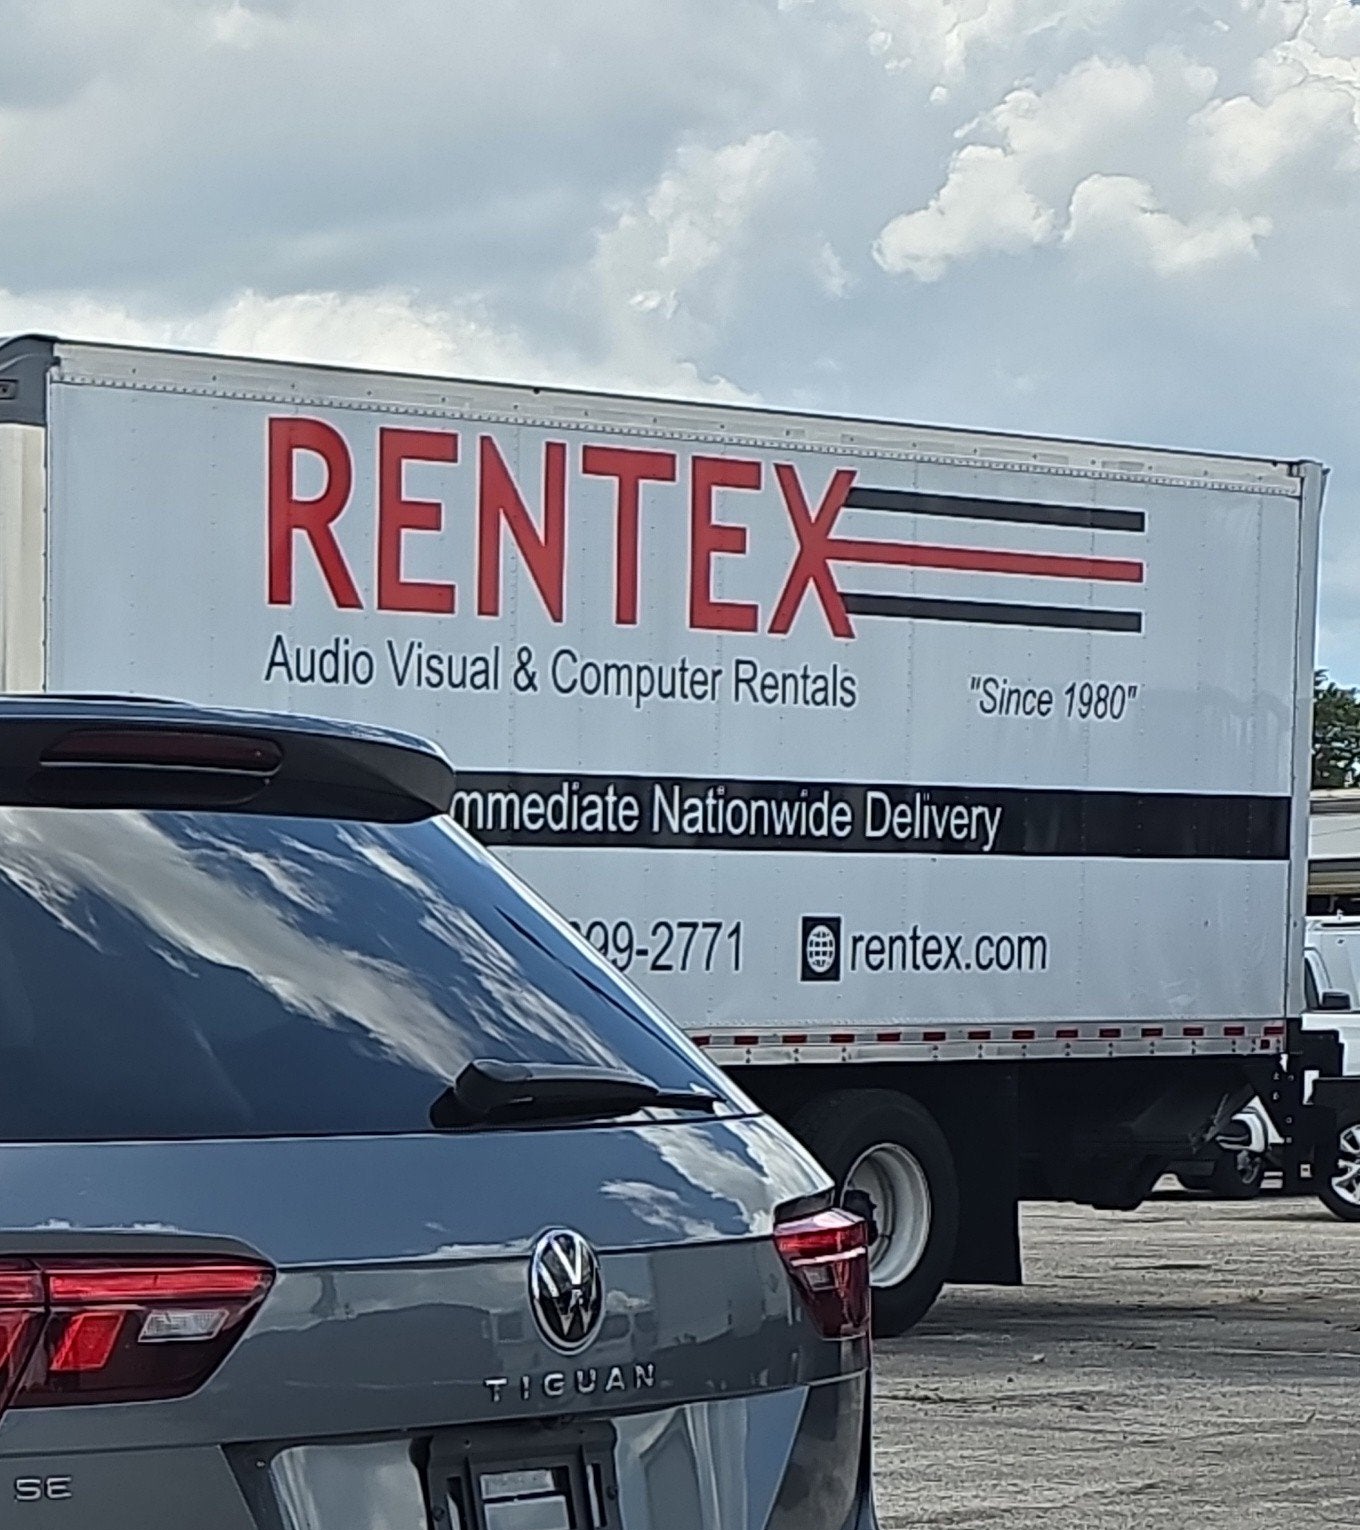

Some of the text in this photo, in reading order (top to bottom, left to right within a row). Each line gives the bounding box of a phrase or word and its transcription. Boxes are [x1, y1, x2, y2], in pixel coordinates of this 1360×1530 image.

[267, 417, 857, 639] RENTEX
[264, 634, 857, 708] Audio Visual & Computer Rentals
[970, 676, 1138, 720] "Since 1980"
[449, 781, 1002, 852] mmediate Nationwide Delivery
[568, 920, 743, 972] 99-2771
[851, 925, 1047, 971] rentex.com
[483, 1362, 657, 1402] TIGUAN
[14, 1475, 73, 1501] SE
